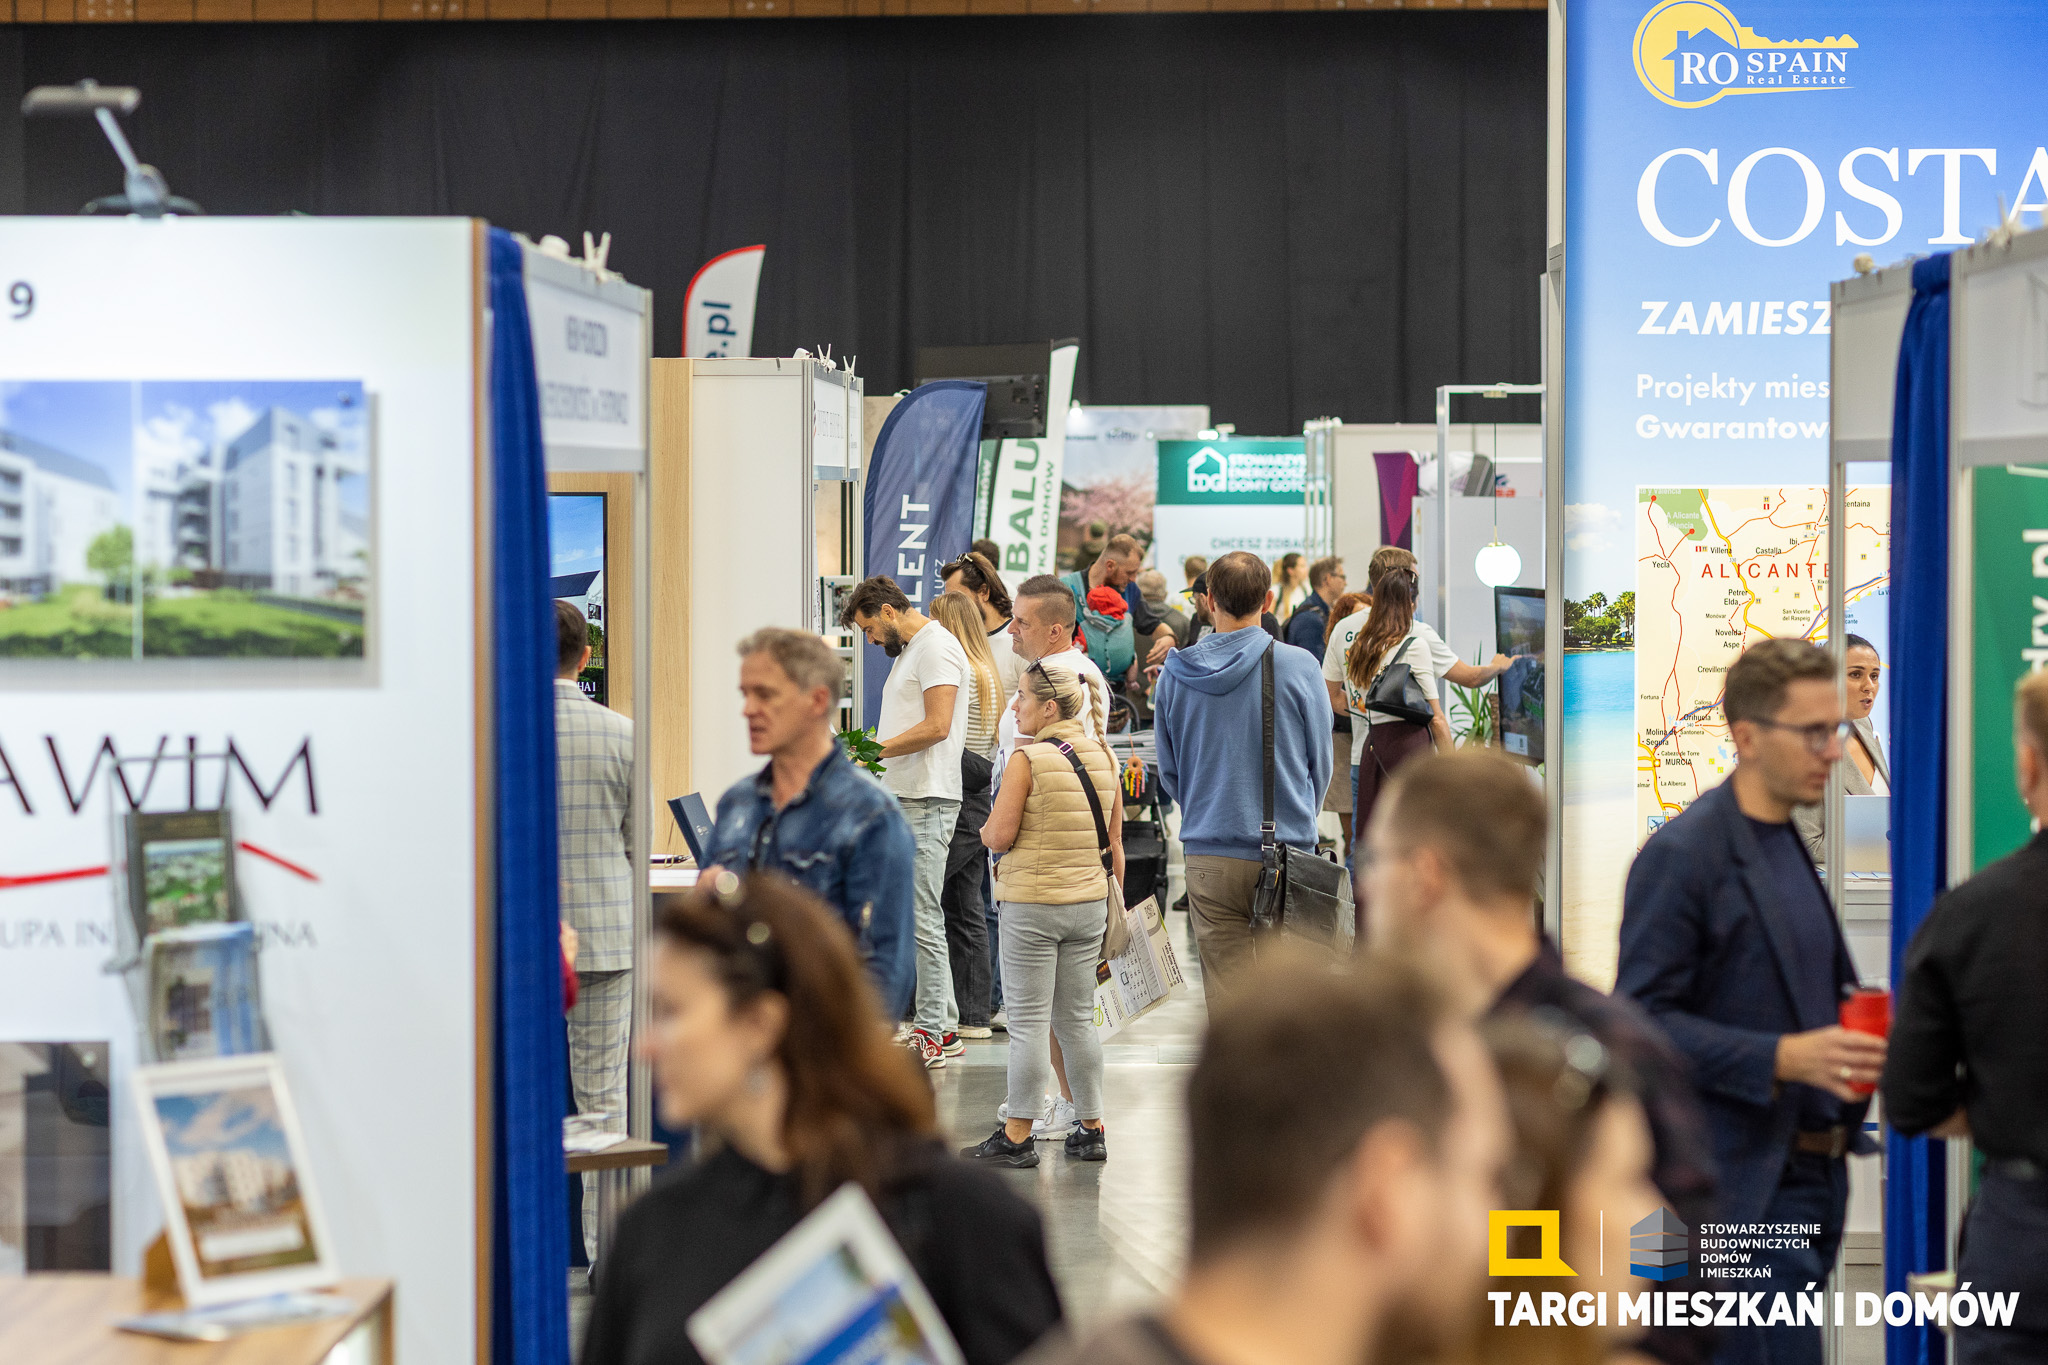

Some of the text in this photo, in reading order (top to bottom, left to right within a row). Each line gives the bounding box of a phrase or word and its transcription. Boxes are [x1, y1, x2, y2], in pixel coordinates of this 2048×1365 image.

[1680, 51, 1848, 85] RO SPAIN
[1747, 74, 1847, 85] Real Estate
[9, 281, 34, 320] 9
[1637, 301, 1831, 335] ZAMIESZ
[1636, 373, 1830, 406] Projekty mies
[1635, 414, 1830, 439] Gwarantow
[1673, 511, 1699, 519] Alicante
[897, 494, 930, 614] LENT
[1755, 547, 1782, 555] Castalla
[1723, 641, 1740, 649] Aspe
[1683, 713, 1711, 721] Orihuela
[1646, 728, 1668, 736] Molina
